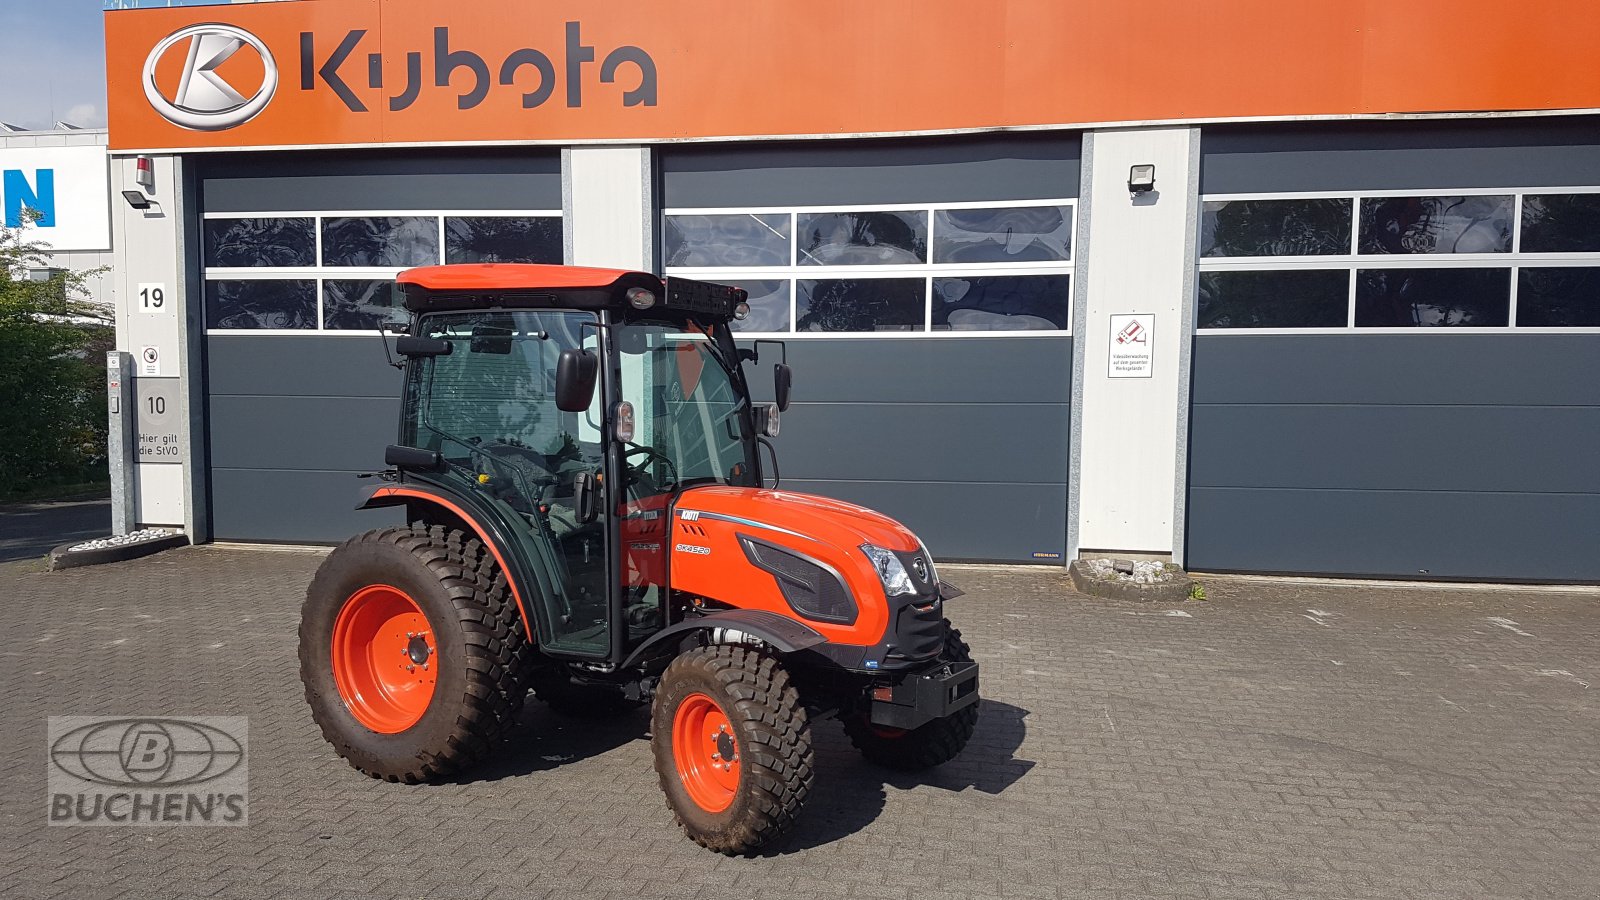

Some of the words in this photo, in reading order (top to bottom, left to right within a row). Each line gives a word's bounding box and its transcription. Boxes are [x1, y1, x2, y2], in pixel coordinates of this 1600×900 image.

[300, 21, 657, 113] Kubota
[140, 287, 164, 308] 19
[148, 396, 166, 415] 10
[139, 433, 158, 443] Hier
[162, 433, 178, 446] gilt
[139, 446, 153, 455] die
[156, 446, 179, 456] StVO
[681, 510, 699, 521] KIOTI
